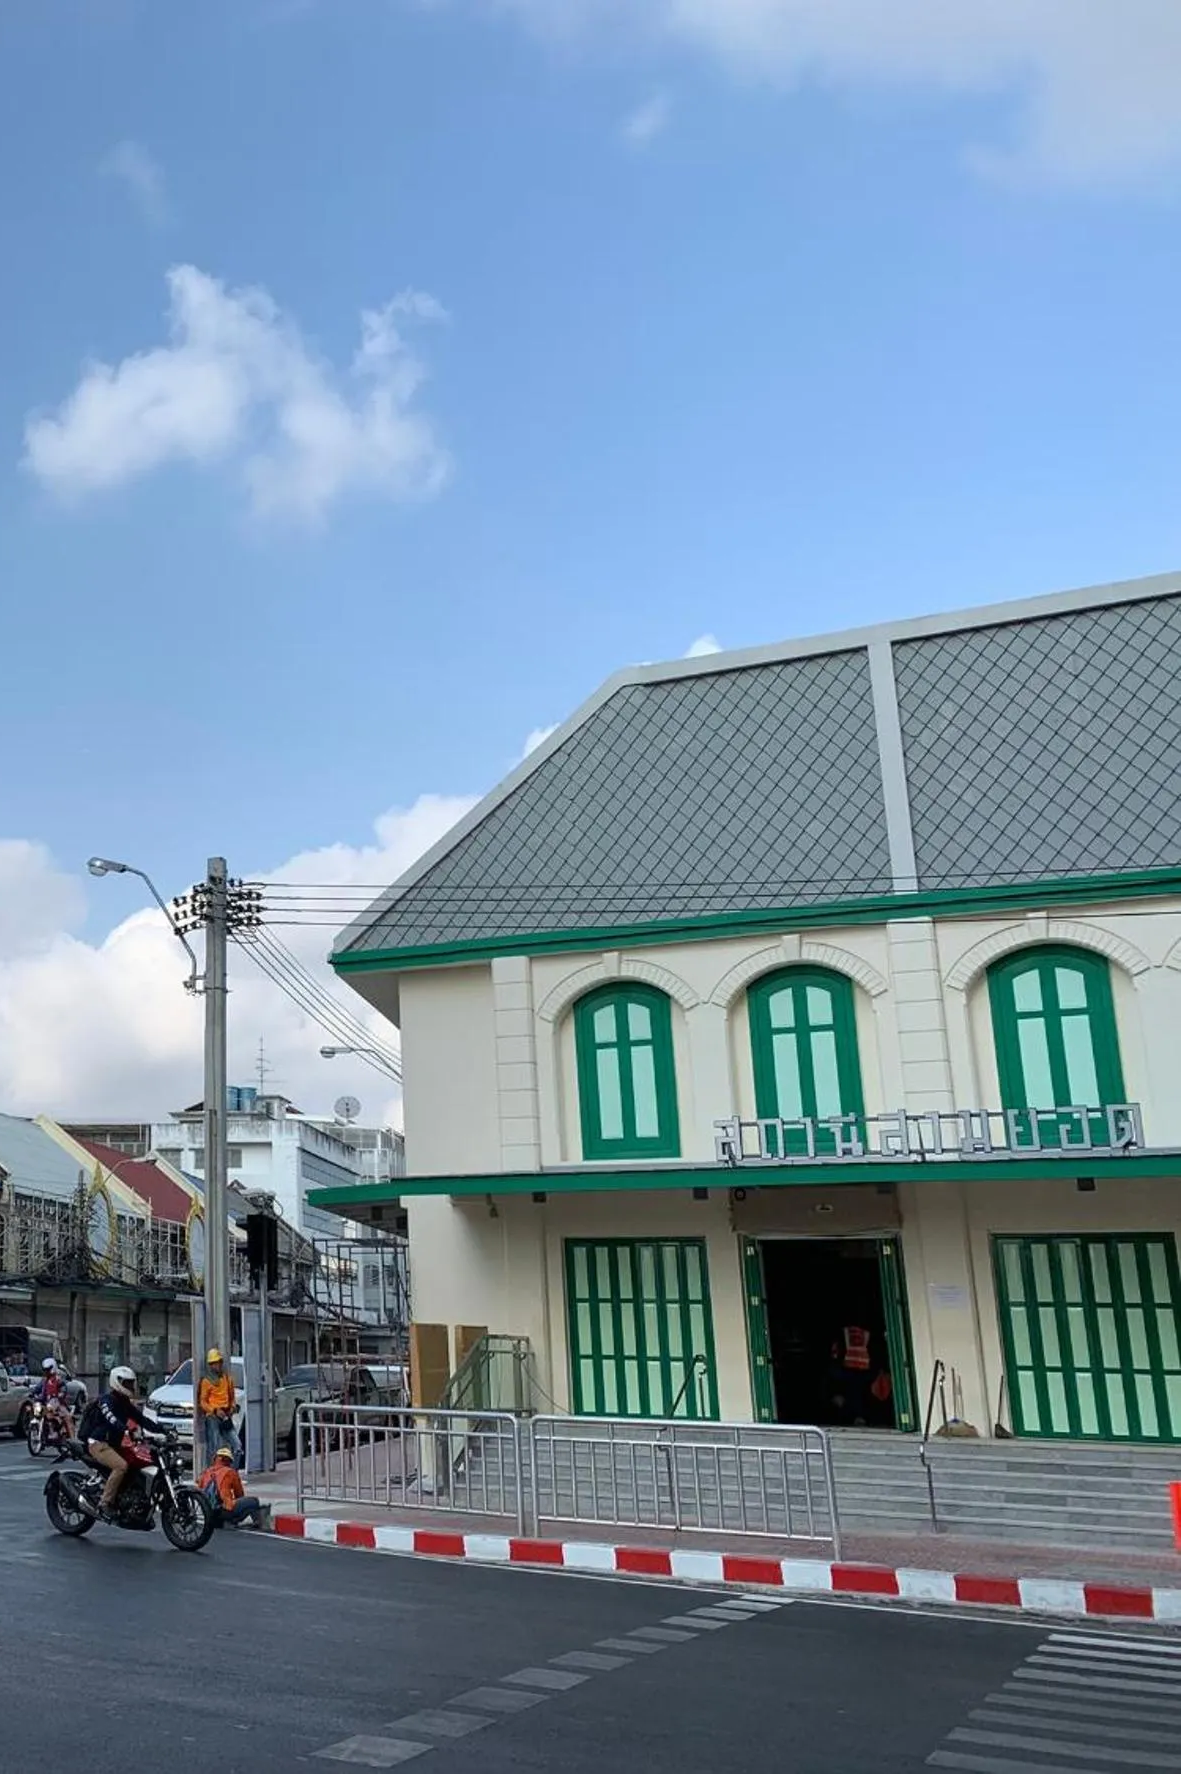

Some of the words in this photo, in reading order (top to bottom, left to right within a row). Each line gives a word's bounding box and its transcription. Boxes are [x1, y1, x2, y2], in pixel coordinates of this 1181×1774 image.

[714, 1103, 1145, 1161] สถานีสามยอด
